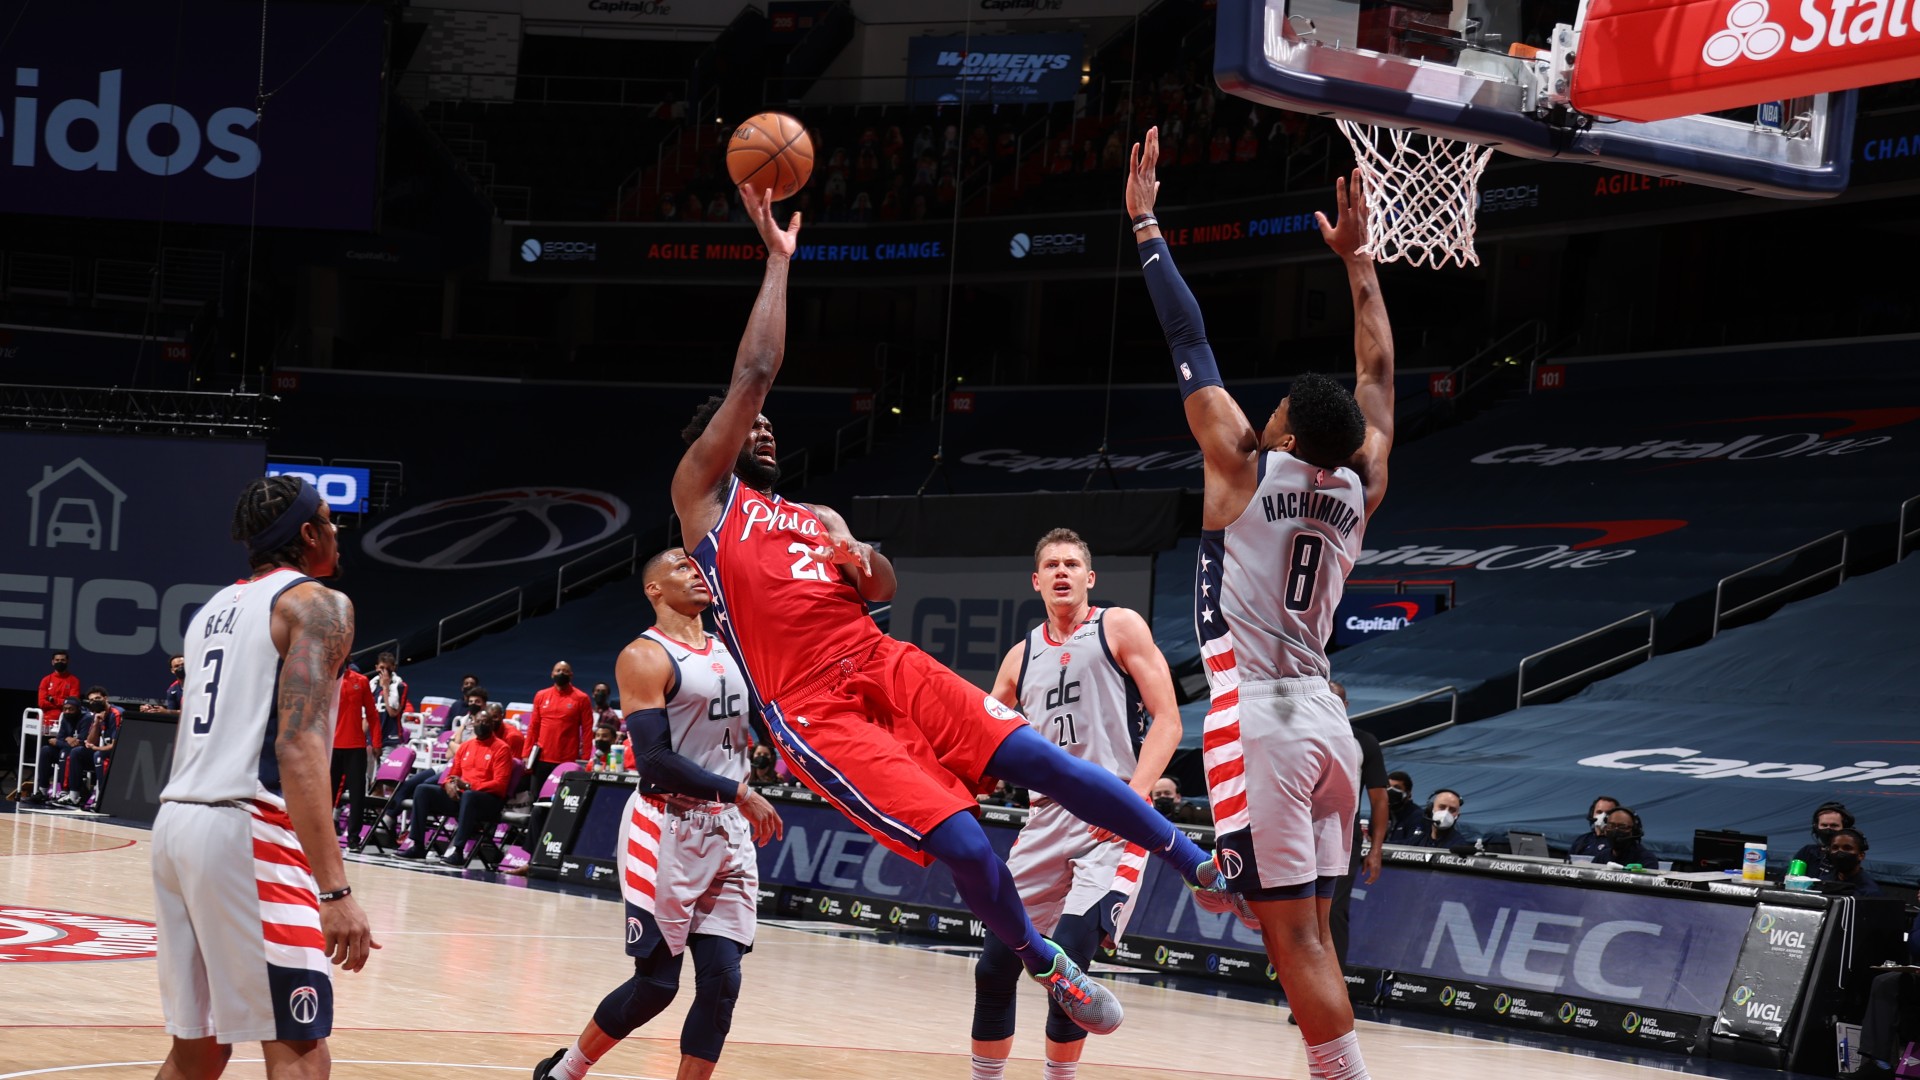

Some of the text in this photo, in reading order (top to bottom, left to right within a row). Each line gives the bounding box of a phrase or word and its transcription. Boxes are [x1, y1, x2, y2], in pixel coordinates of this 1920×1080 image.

[1790, 0, 1920, 53] Stat
[937, 51, 1072, 69] WOMEN'S
[955, 67, 1048, 83] NIGHT
[1762, 104, 1779, 123] NBA
[0, 68, 262, 180] idos
[1594, 173, 1652, 196] AGILE
[1482, 184, 1540, 201] EPOCH
[1192, 221, 1246, 244] MINDS.
[544, 241, 597, 252] EPOCH
[1032, 233, 1086, 247] EPOCH
[647, 243, 700, 260] AGILE
[874, 240, 946, 261] CHANGE.
[167, 348, 186, 359] 104
[277, 377, 297, 388] 103
[1433, 379, 1452, 393] 102
[1541, 372, 1560, 386] 101
[953, 397, 971, 411] 102
[1262, 491, 1360, 540] HACHIMURA
[1284, 531, 1325, 614] 8
[204, 607, 244, 639] BEAL
[192, 646, 225, 737] 3
[1053, 713, 1078, 747] 21
[721, 727, 733, 760] 4
[563, 795, 580, 807] WGL
[546, 842, 563, 854] WGL
[771, 825, 903, 896] NEC
[1489, 861, 1526, 873] #ASKWGL
[1651, 877, 1693, 890] WGL.COM
[1769, 928, 1806, 949] WGL
[1421, 900, 1662, 999] NEC
[1217, 963, 1230, 972] Gas
[1219, 957, 1250, 968] Washington
[1391, 988, 1404, 997] Gas
[1393, 982, 1427, 993] Washington
[1456, 990, 1471, 1000] WGL
[1454, 999, 1477, 1009] Energy
[1512, 997, 1527, 1008] WGL
[1509, 1006, 1544, 1018] Midstream
[1577, 1007, 1592, 1017] WGL
[1746, 1001, 1782, 1021] WGL
[1574, 1015, 1599, 1028] Energy
[1642, 1017, 1658, 1028] WGL
[1639, 1026, 1677, 1039] Midstream
